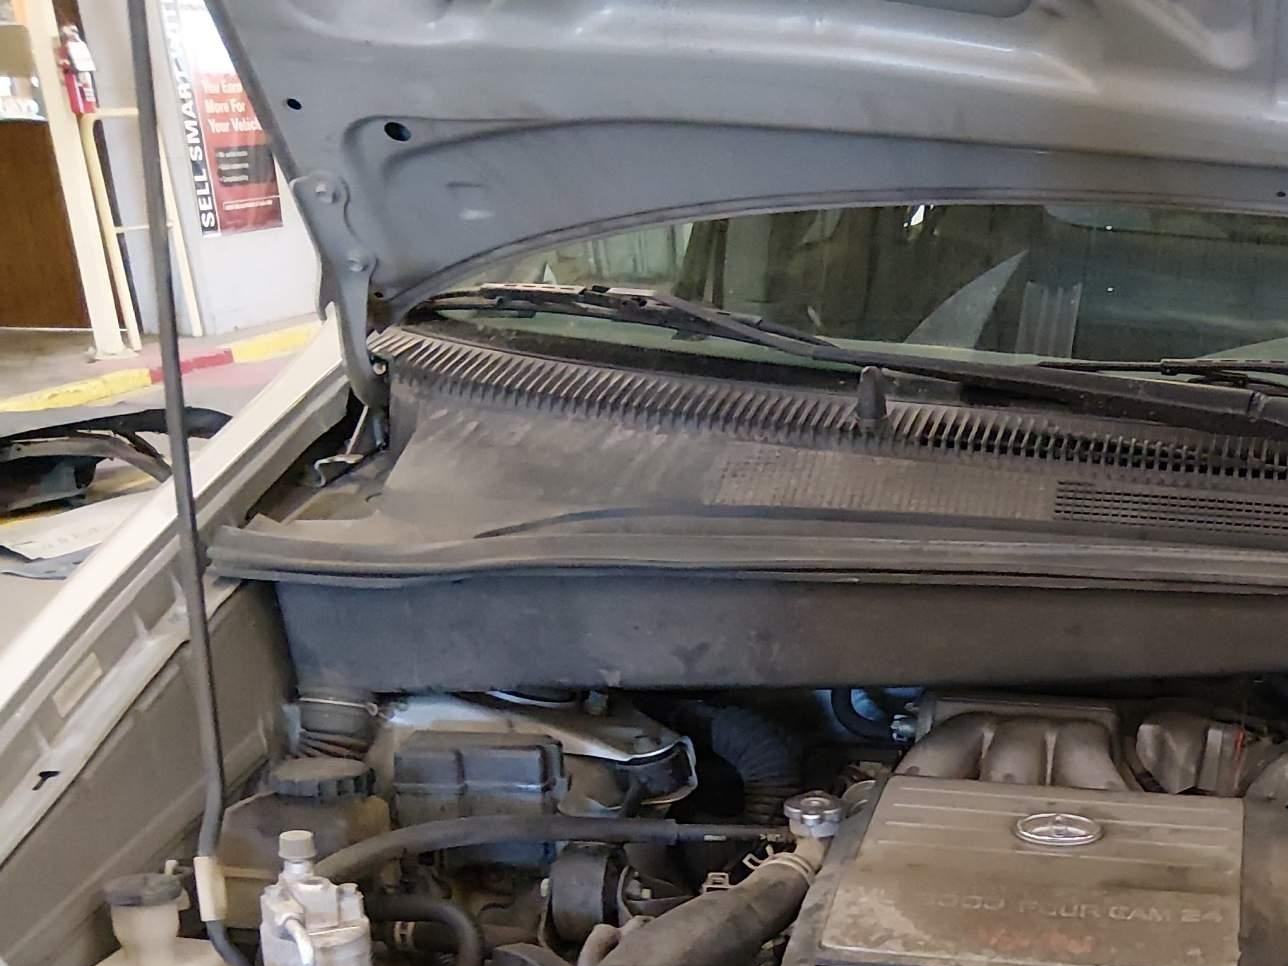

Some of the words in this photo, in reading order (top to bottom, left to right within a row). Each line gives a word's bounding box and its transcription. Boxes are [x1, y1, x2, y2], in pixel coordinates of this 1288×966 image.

[204, 98, 229, 113] More
[229, 97, 246, 113] For
[175, 69, 203, 161] SMART
[208, 118, 230, 133] Your
[193, 168, 216, 228] SELL
[1109, 905, 1171, 922] CAM
